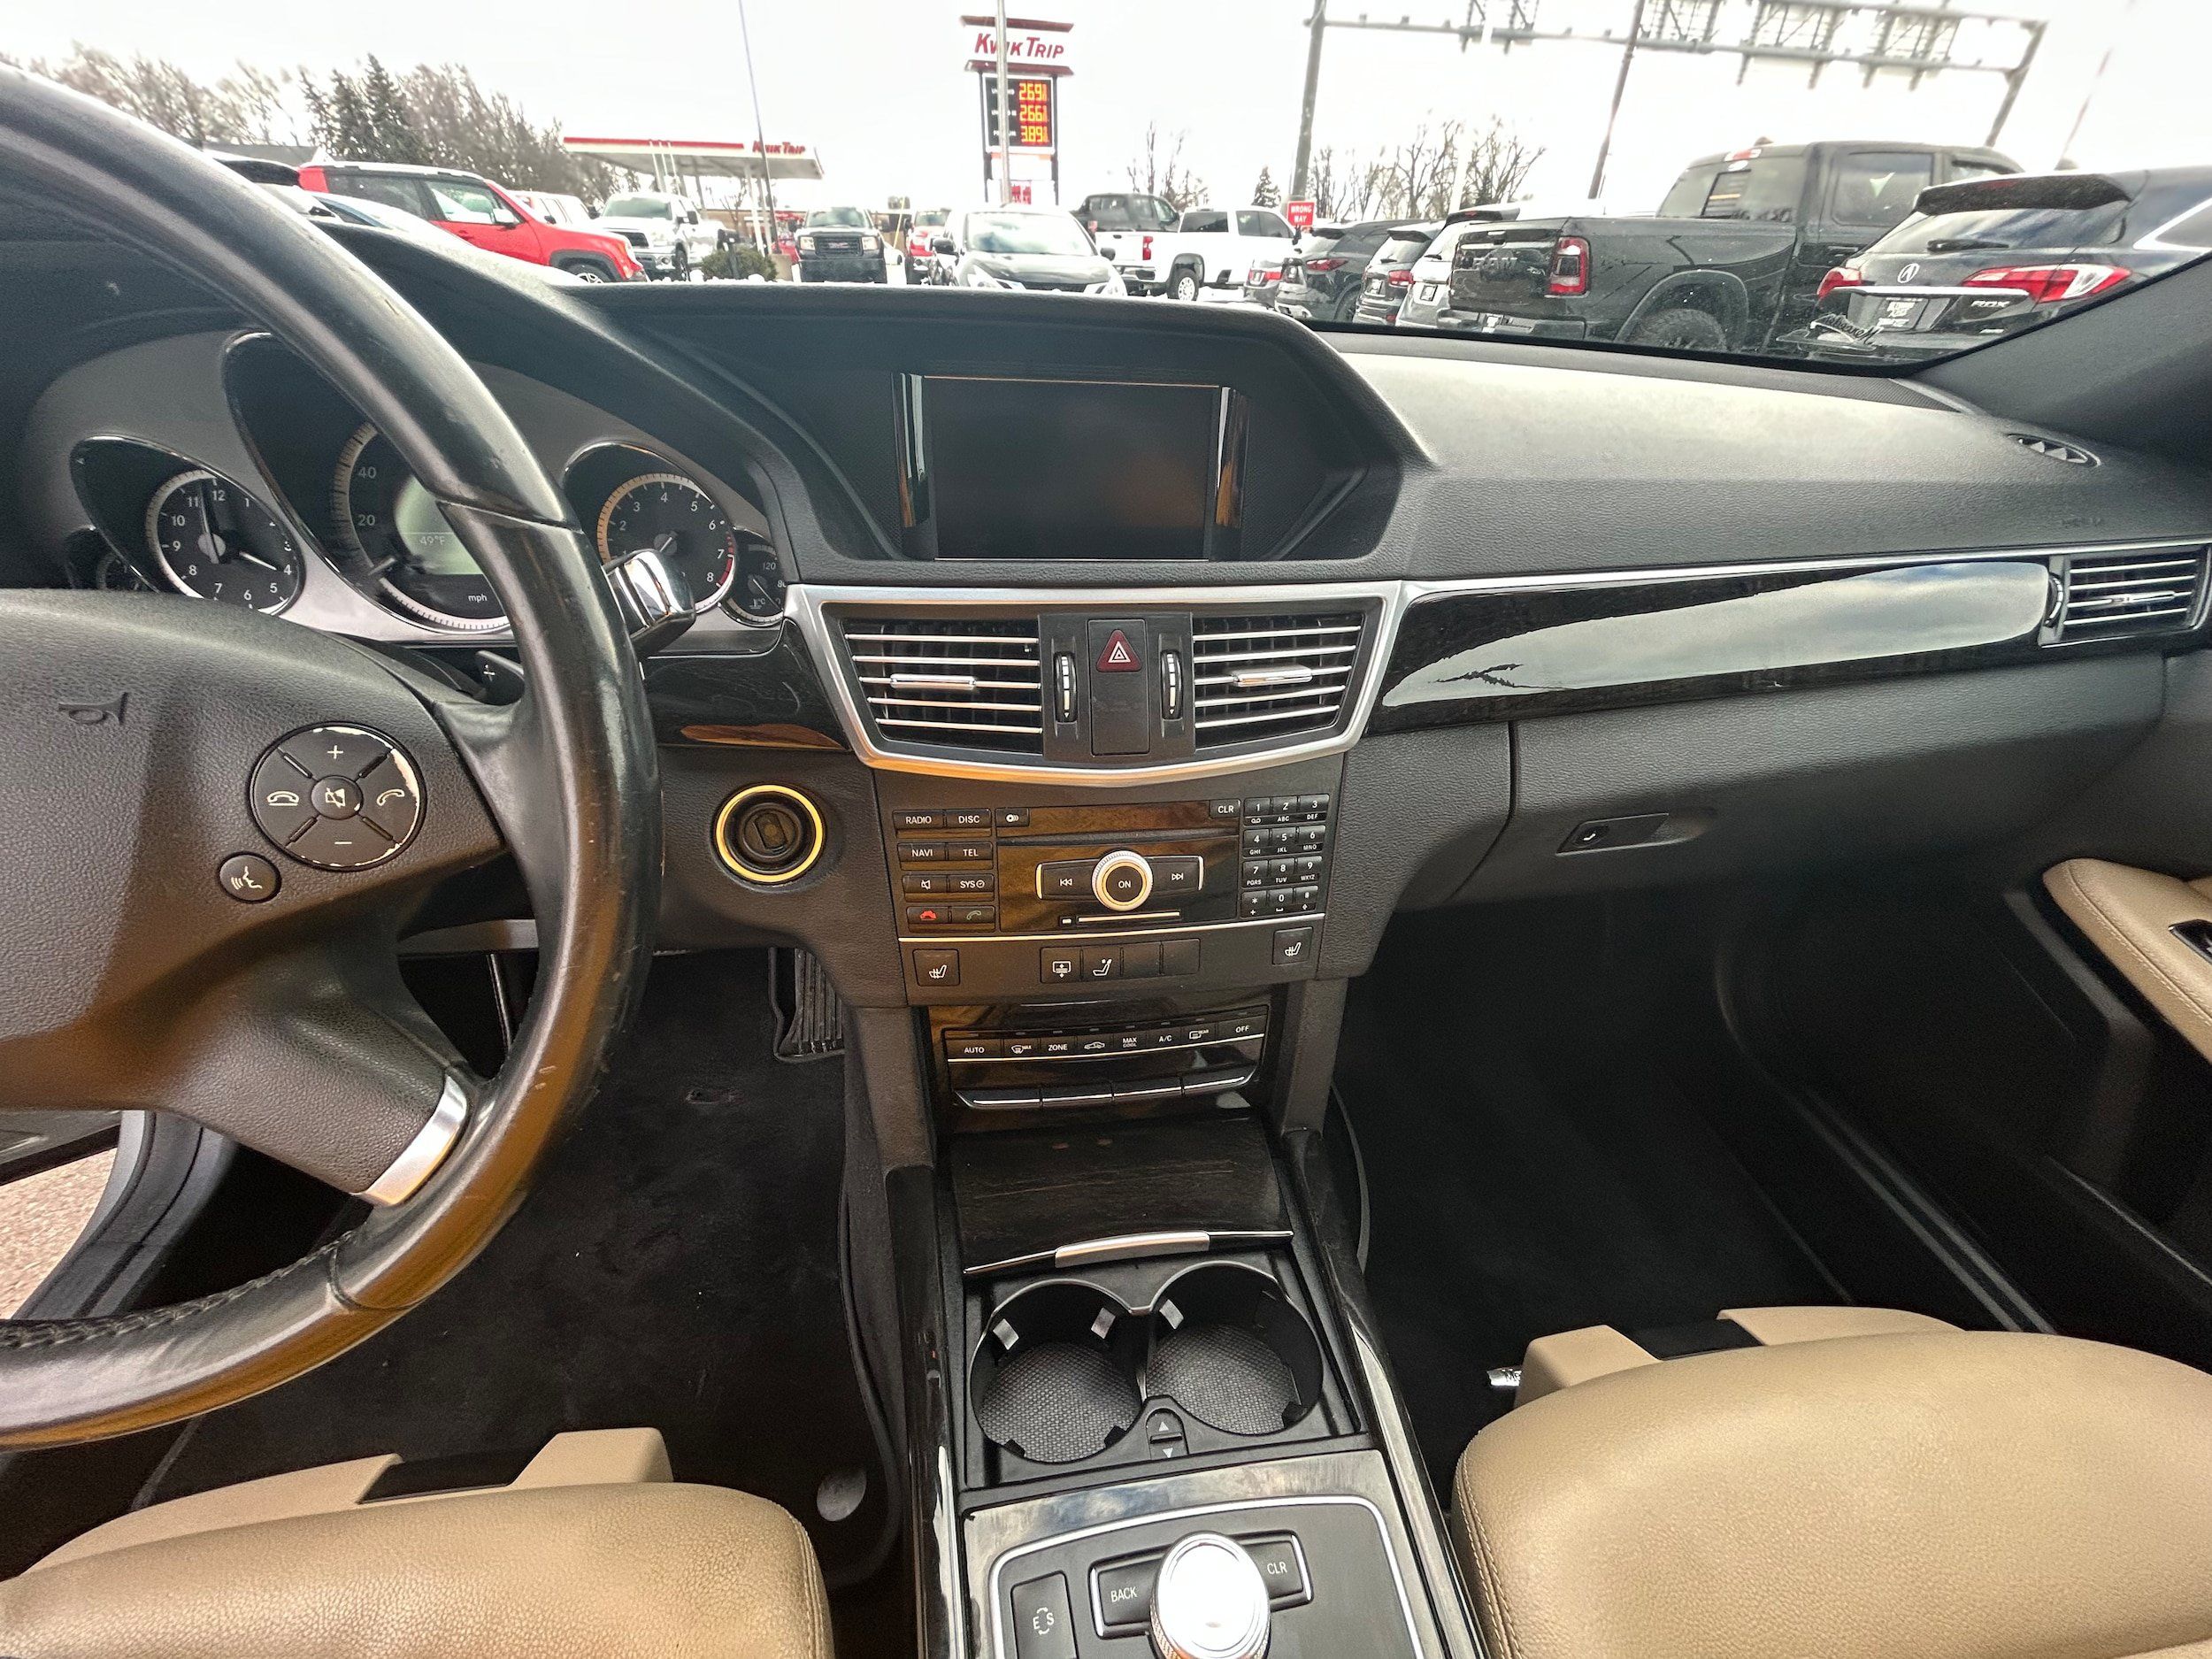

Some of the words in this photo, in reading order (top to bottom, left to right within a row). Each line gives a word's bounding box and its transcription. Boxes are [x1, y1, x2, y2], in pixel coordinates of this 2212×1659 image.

[1026, 36, 1064, 58] TRIP
[1291, 204, 1312, 213] WRONG
[358, 466, 377, 479] 40
[212, 489, 227, 502] 12
[660, 492, 669, 503] 4
[187, 496, 199, 508] 11
[244, 497, 250, 508] 1
[633, 502, 641, 512] 3
[690, 501, 698, 512] 5
[172, 514, 186, 526] 10
[358, 514, 376, 526] 20
[709, 520, 717, 530] 6
[618, 520, 626, 531] 2
[173, 540, 181, 551] 9
[717, 549, 725, 559] 7
[188, 565, 197, 576] 8
[283, 564, 293, 576] 4
[763, 562, 777, 571] 120
[706, 572, 715, 583] 8
[214, 582, 223, 594] 7
[269, 582, 278, 594] 5
[243, 589, 252, 601] 6
[468, 594, 488, 603] mph
[1217, 805, 1234, 814] CLR
[1282, 802, 1289, 810] 2
[1312, 800, 1318, 809] 3
[905, 815, 933, 825] RADIO
[958, 815, 980, 824] DISC
[1254, 834, 1260, 843] 4
[1281, 833, 1287, 841] 5
[1310, 831, 1316, 840] 6
[911, 849, 933, 857] NAVI
[963, 849, 979, 857] TEL
[1253, 865, 1259, 874] 7
[1279, 864, 1286, 872] 8
[960, 879, 976, 889] SYS
[1118, 879, 1132, 889] ON
[1279, 894, 1285, 902] 0
[1235, 1025, 1250, 1033] OFF
[1158, 1034, 1172, 1043] A/C
[1266, 1562, 1288, 1576] CLR
[1110, 1586, 1138, 1602] BACK
